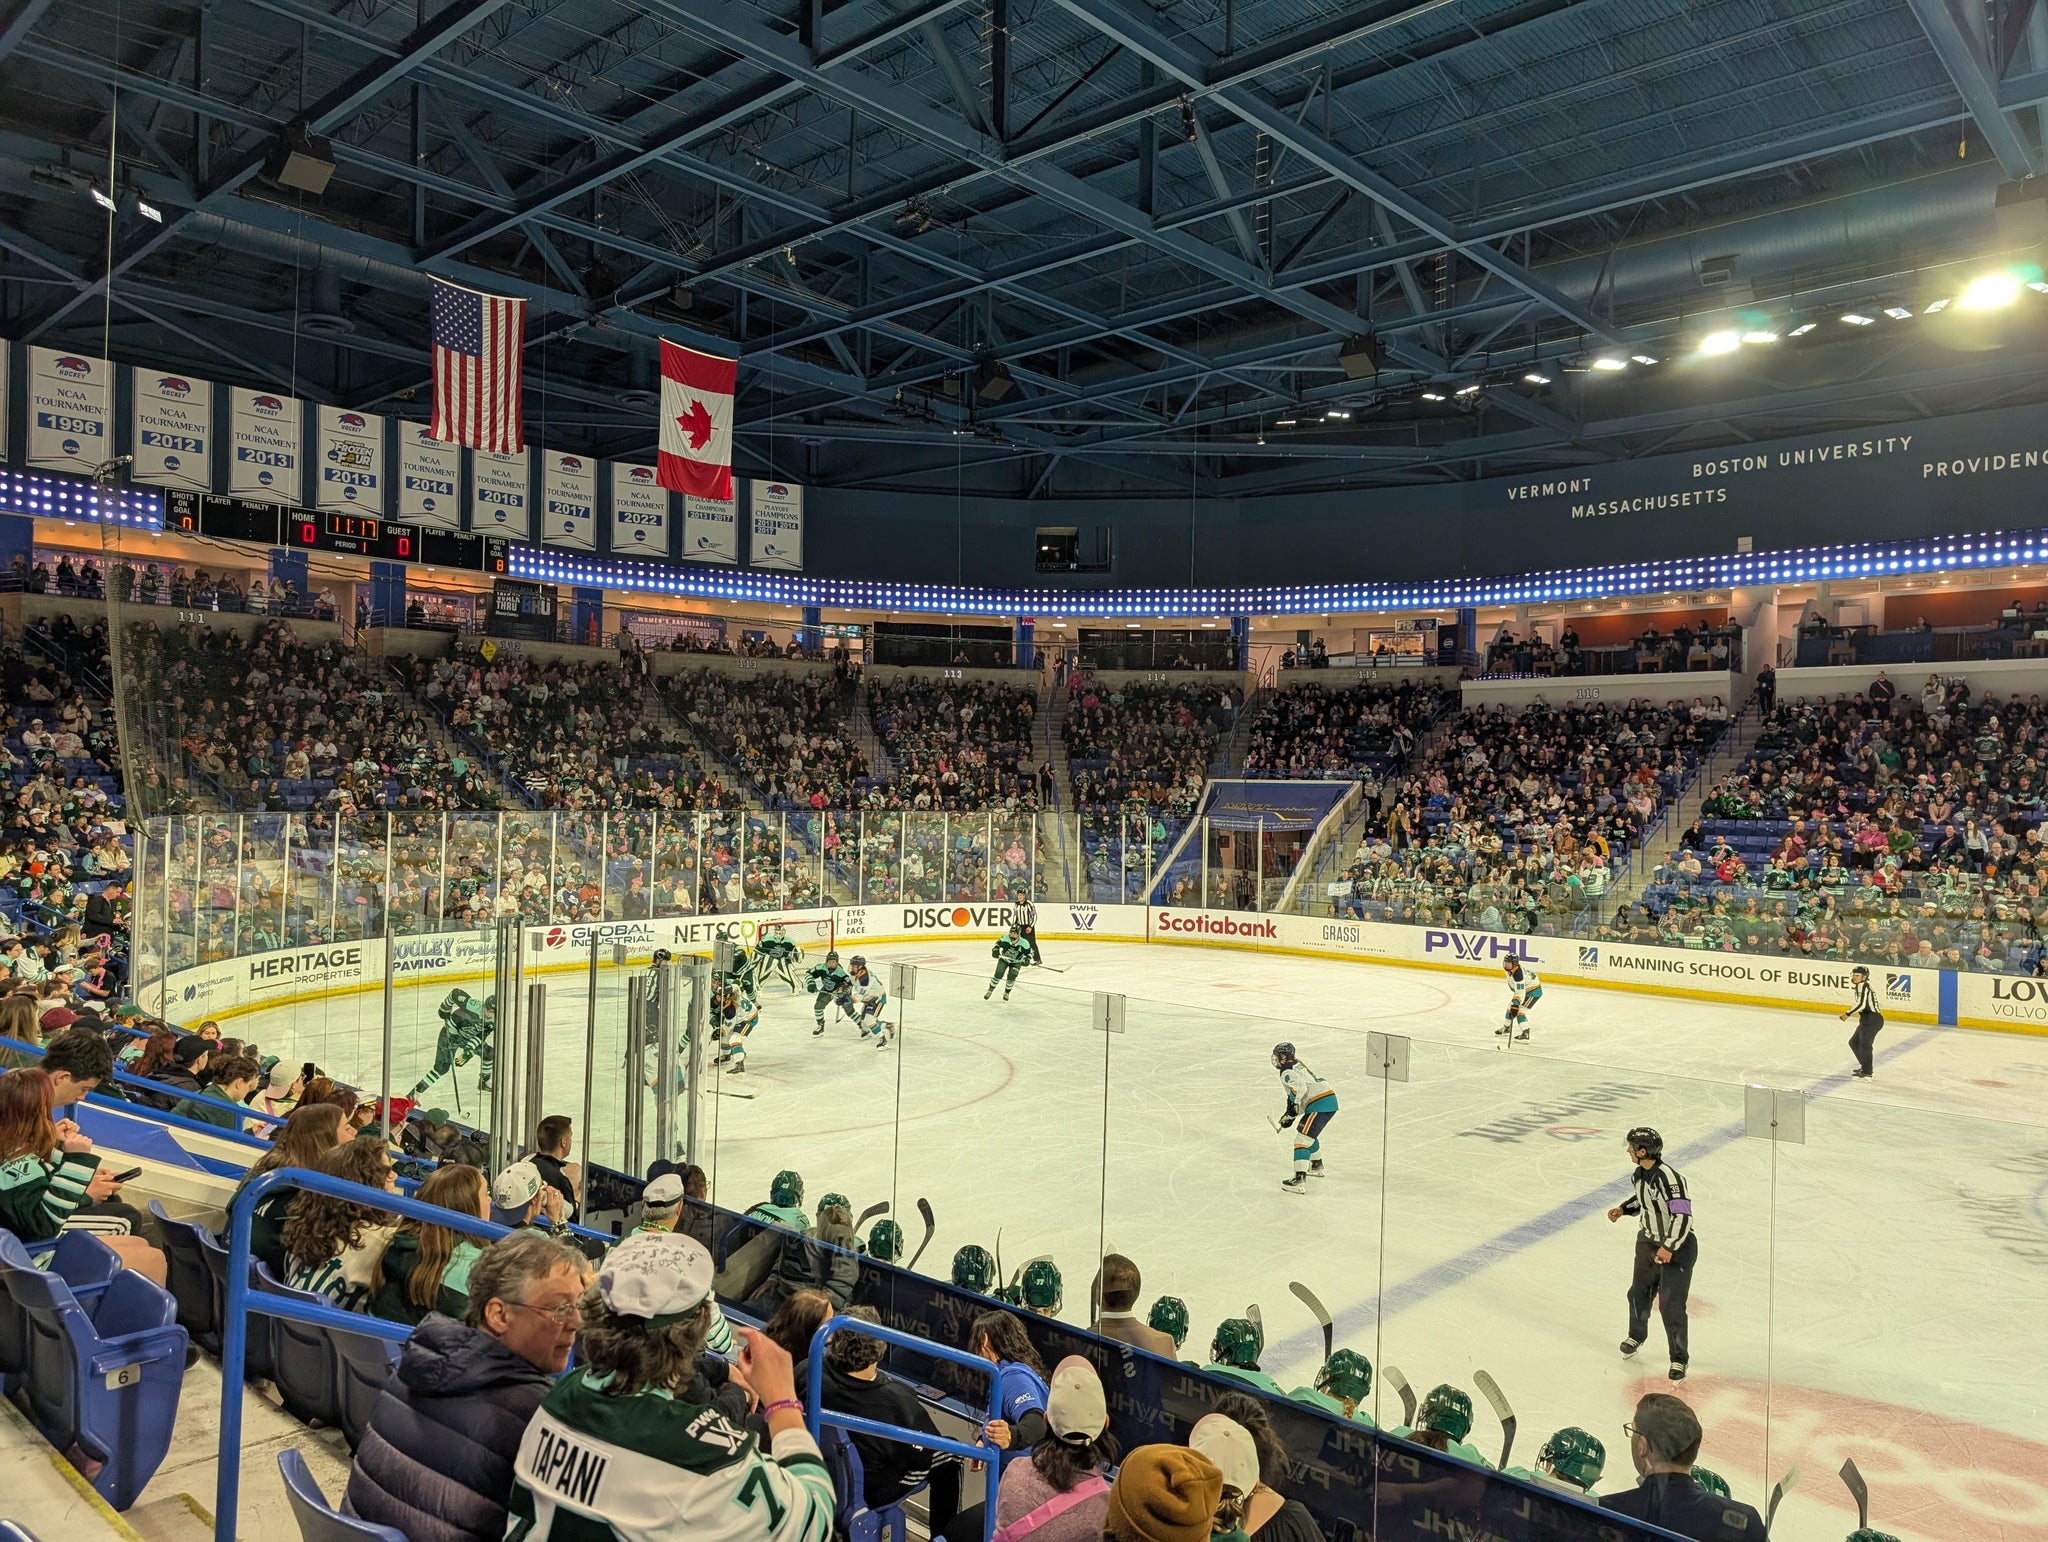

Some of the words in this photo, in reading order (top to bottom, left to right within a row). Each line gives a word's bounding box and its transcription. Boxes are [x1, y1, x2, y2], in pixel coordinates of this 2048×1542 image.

[59, 369, 86, 380] HOCKEY
[57, 388, 87, 401] NCAA
[161, 389, 186, 399] HOCKEY
[34, 396, 108, 416] TOURNAMENT
[256, 408, 278, 417] HOCKEY
[159, 407, 187, 420] NCAA
[47, 415, 97, 435] 1996
[139, 415, 206, 434] TOURNAMENT
[254, 425, 279, 436] NCAA
[341, 425, 361, 433] HOCKEY
[150, 432, 196, 452] 2012
[235, 432, 297, 450] TOURNAMENT
[334, 441, 374, 457] FROZEN
[245, 449, 288, 467] 2013
[419, 455, 441, 466] NCAA
[1693, 456, 1769, 478] BOSTON
[1780, 436, 1913, 467] UNIVERSITY
[404, 463, 456, 478] TOURNAMENT
[491, 469, 512, 479] NCAA
[331, 470, 371, 486] 2013
[477, 475, 525, 490] TOURNAMENT
[411, 478, 448, 494] 2014
[560, 481, 580, 491] NCAA
[1507, 478, 1591, 500] VERMONT
[171, 491, 194, 501] SHOTS
[484, 490, 518, 506] 2016
[547, 487, 592, 502] TOURNAMENT
[631, 492, 650, 501] NCAA
[174, 506, 191, 515] GOAL
[206, 496, 231, 506] PLAYER
[241, 501, 269, 512] PENALTY
[554, 502, 586, 517] 2017
[616, 499, 664, 510] TOURNAMENT
[695, 504, 726, 513] CHAMPIONS
[764, 504, 789, 513] PLAYOFF
[1571, 489, 1727, 519] MASSACHUSETTS
[291, 512, 315, 523] HOME
[624, 512, 657, 526] 2022
[755, 510, 799, 521] CHAMPIONS
[303, 524, 316, 543] 0
[335, 516, 376, 538] 11:17
[387, 526, 411, 537] GUEST
[425, 528, 446, 537] PLAYER
[453, 532, 476, 542] PENALTY
[488, 538, 506, 546] SHOTS
[335, 540, 356, 549] PERIOD
[398, 538, 410, 556] 0
[490, 550, 503, 558] GOAL
[496, 559, 504, 572] 8
[178, 611, 205, 624] 111
[738, 658, 758, 669] 113
[944, 669, 963, 679] 113
[1147, 672, 1167, 682] 114
[1358, 669, 1378, 680] 115
[1576, 687, 1600, 699] 116
[1069, 904, 1098, 912] PWHL
[904, 907, 1013, 929] DISCOVER
[1158, 911, 1278, 939] Scotiabank
[571, 923, 655, 939] GLOBAL
[674, 918, 783, 944] NETSCO
[1322, 924, 1360, 943] GRASSI
[571, 934, 655, 948] INDUSTRIAL
[1425, 930, 1539, 963] PWHL
[393, 937, 454, 960] OULEY
[250, 947, 361, 981] HERITAGE
[393, 957, 446, 972] PAVING
[295, 968, 361, 985] PROPERTIES
[1609, 954, 1685, 975] MANNING
[1689, 962, 1755, 981] SCHOOL
[1760, 969, 1782, 983] OF
[1788, 971, 1857, 990] BUSINE
[1669, 1184, 1680, 1193] 39
[118, 1370, 129, 1385] 6
[531, 1427, 607, 1507] TAPANI
